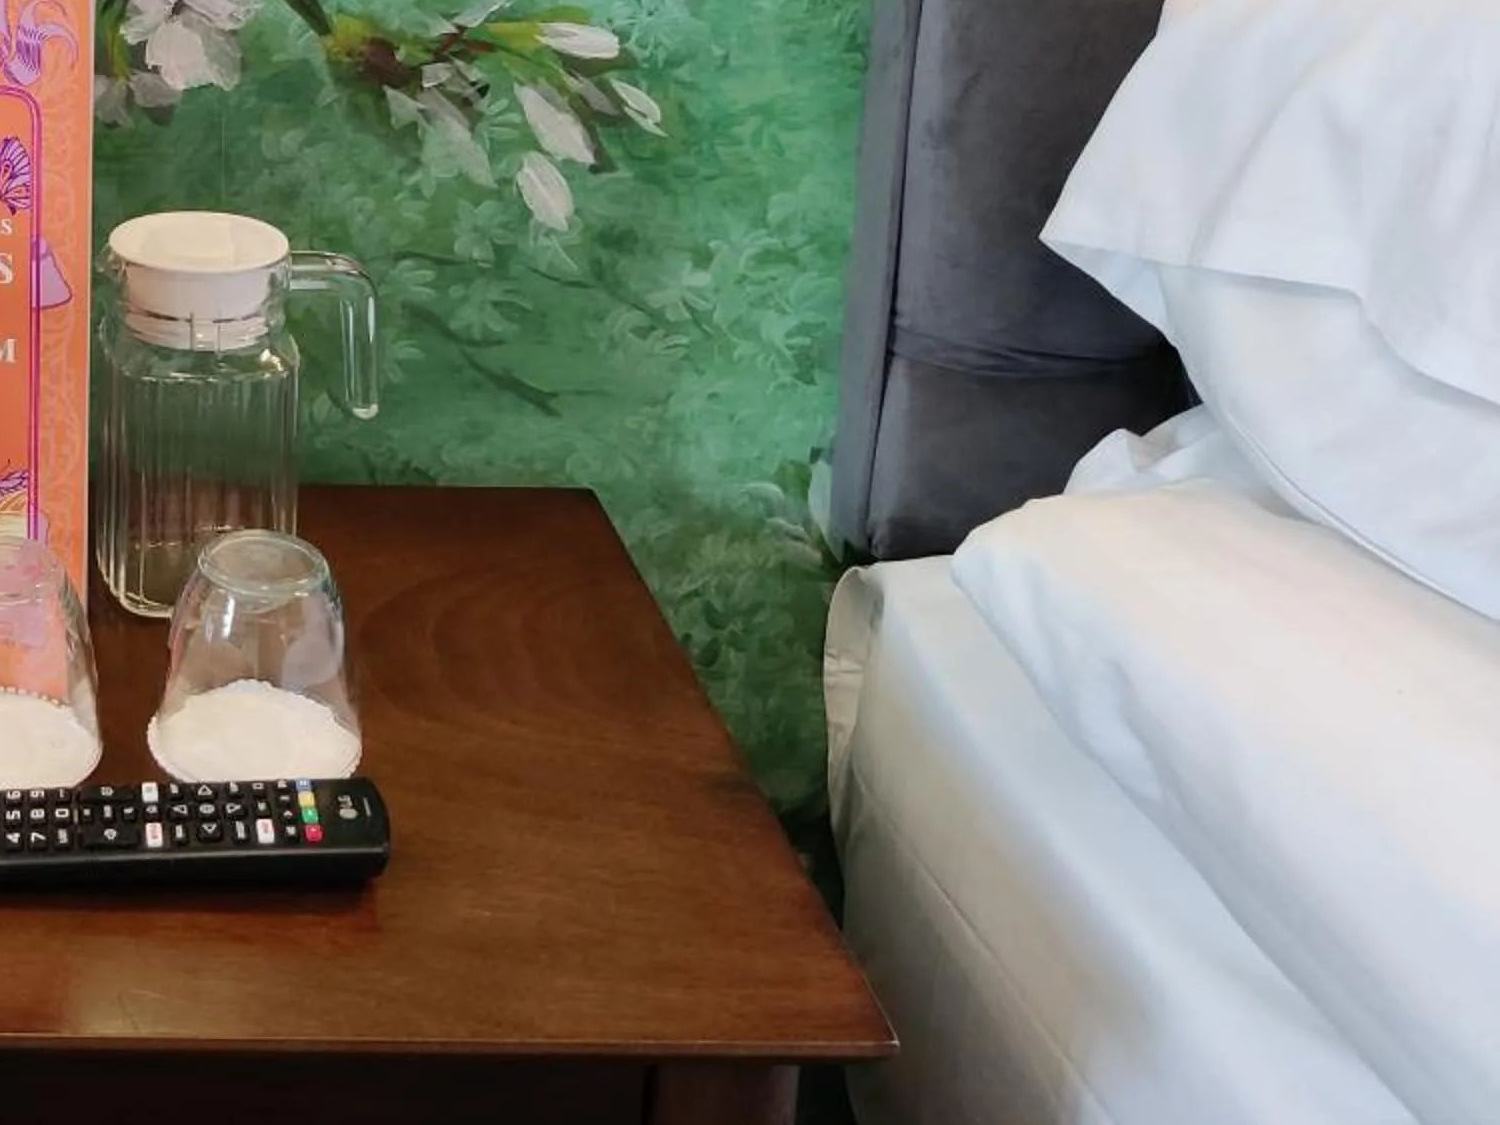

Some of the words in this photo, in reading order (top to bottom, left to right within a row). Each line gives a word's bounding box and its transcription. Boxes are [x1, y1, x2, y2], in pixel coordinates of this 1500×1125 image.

[6, 810, 21, 820] 5
[30, 809, 45, 819] 8
[55, 808, 70, 818] 0
[6, 832, 21, 843] 4
[30, 832, 46, 843] 7
